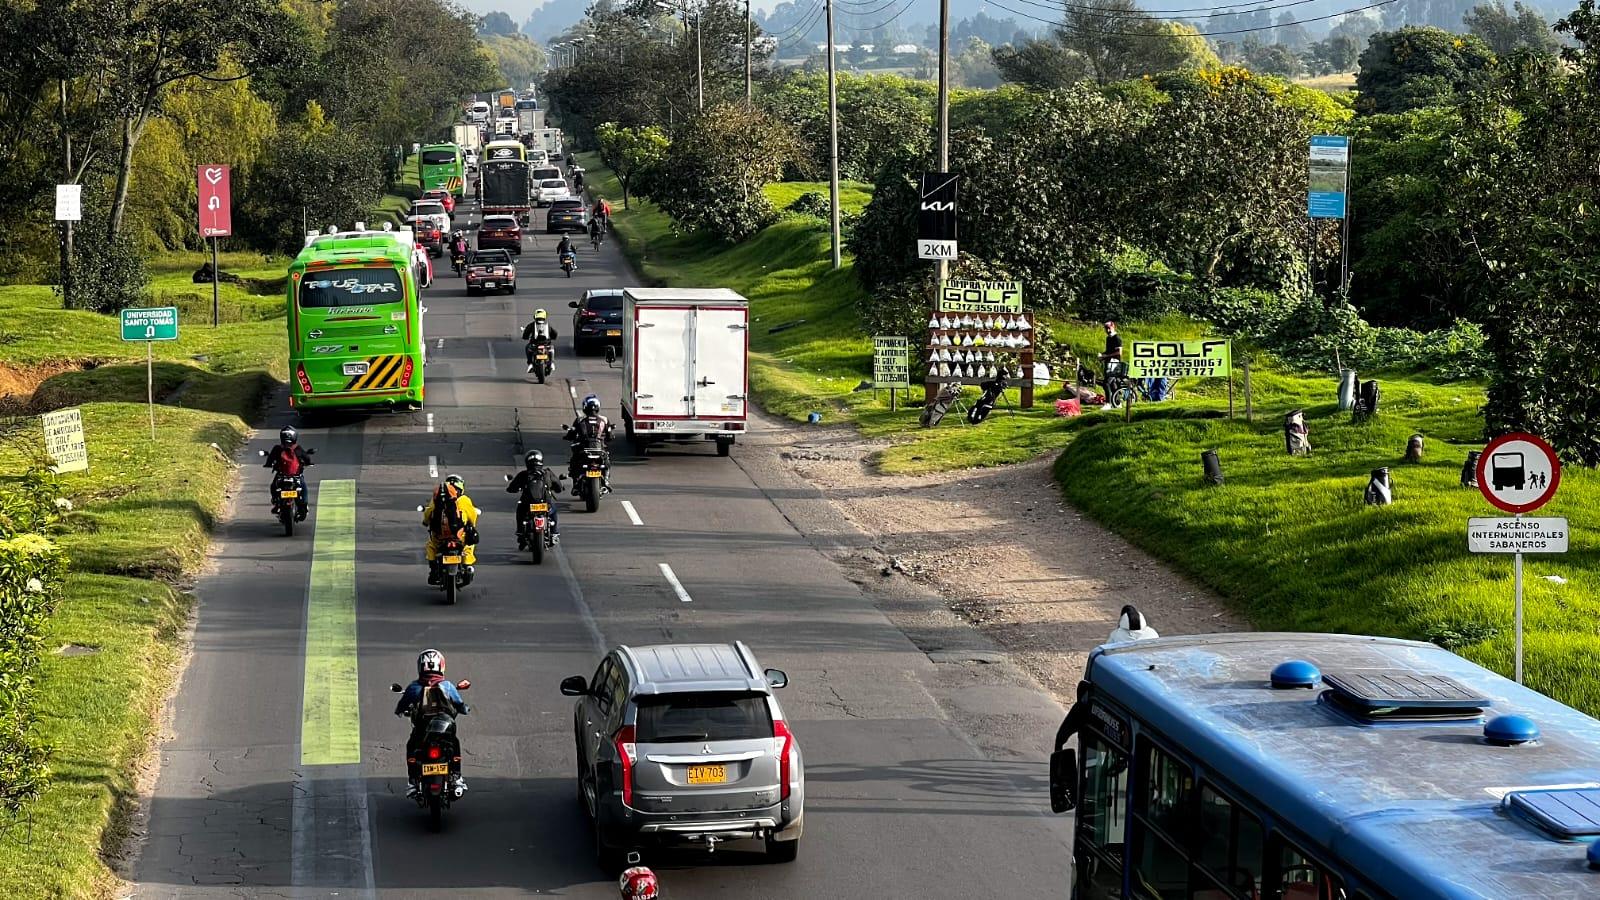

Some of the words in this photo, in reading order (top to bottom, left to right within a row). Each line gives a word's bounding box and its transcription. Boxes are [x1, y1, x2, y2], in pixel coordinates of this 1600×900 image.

[924, 244, 952, 257] 2KM
[945, 279, 981, 290] COMPRA
[985, 281, 1017, 291] VENTA
[943, 288, 1018, 304] GOLF
[126, 310, 173, 319] UNIVERSIDAD
[124, 318, 149, 327] SANTO
[1133, 341, 1225, 357] GOLF
[1472, 531, 1564, 539] INTERMUNICIPALES
[1489, 541, 1547, 549] SABANEROS
[688, 767, 705, 779] EIV
[707, 767, 724, 778] 703
